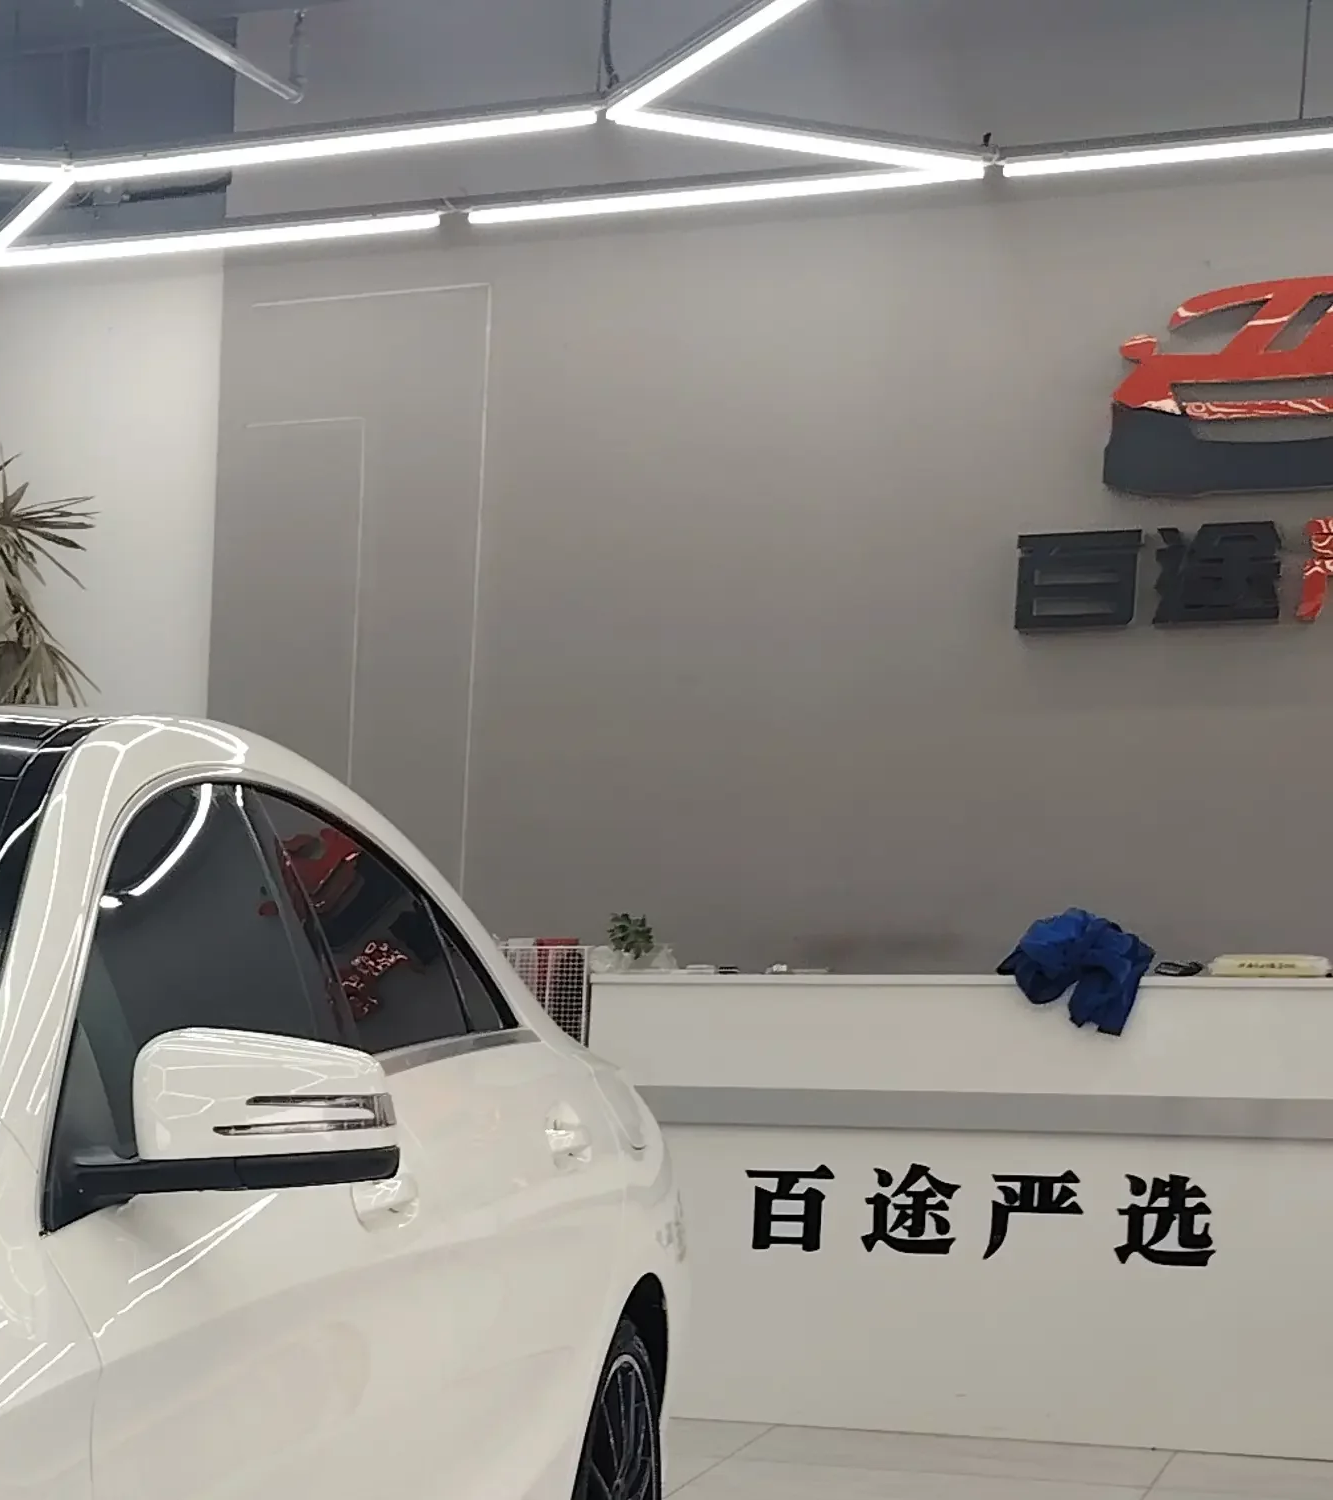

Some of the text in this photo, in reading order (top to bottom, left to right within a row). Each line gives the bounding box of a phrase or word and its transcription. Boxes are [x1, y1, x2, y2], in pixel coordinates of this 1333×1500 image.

[1015, 515, 1333, 632] 百途
[745, 1162, 1217, 1267] 百途严选
